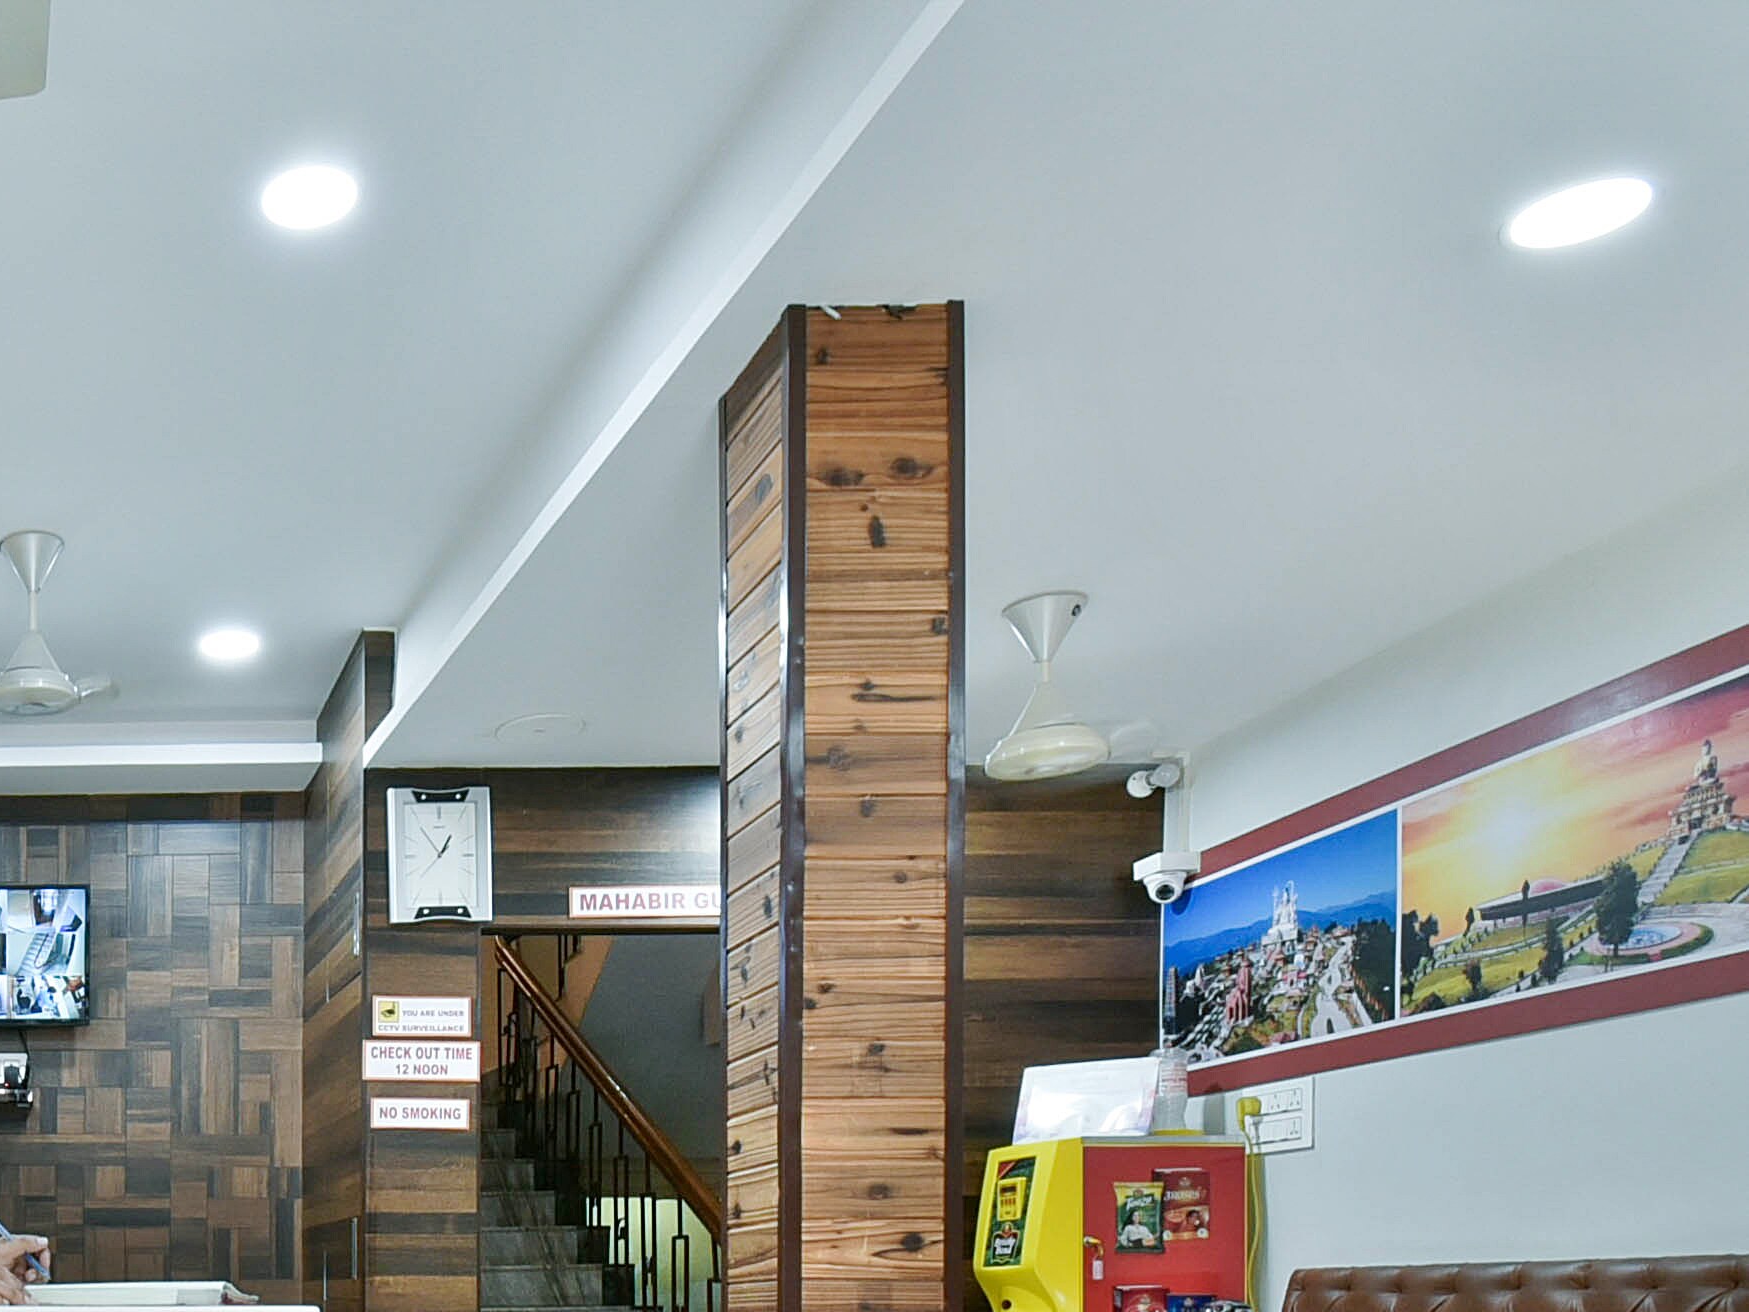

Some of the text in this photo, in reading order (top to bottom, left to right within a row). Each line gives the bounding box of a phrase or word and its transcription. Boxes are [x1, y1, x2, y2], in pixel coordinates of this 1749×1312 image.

[579, 892, 686, 911] MAHABIR
[402, 1009, 464, 1017] YOU ARE UNDER
[378, 1024, 464, 1032] CCTV SURVEILLANCE
[370, 1046, 472, 1060] CHECK OUT TIME
[395, 1063, 448, 1075] 12 NOON
[379, 1107, 461, 1120] NO SMOKING
